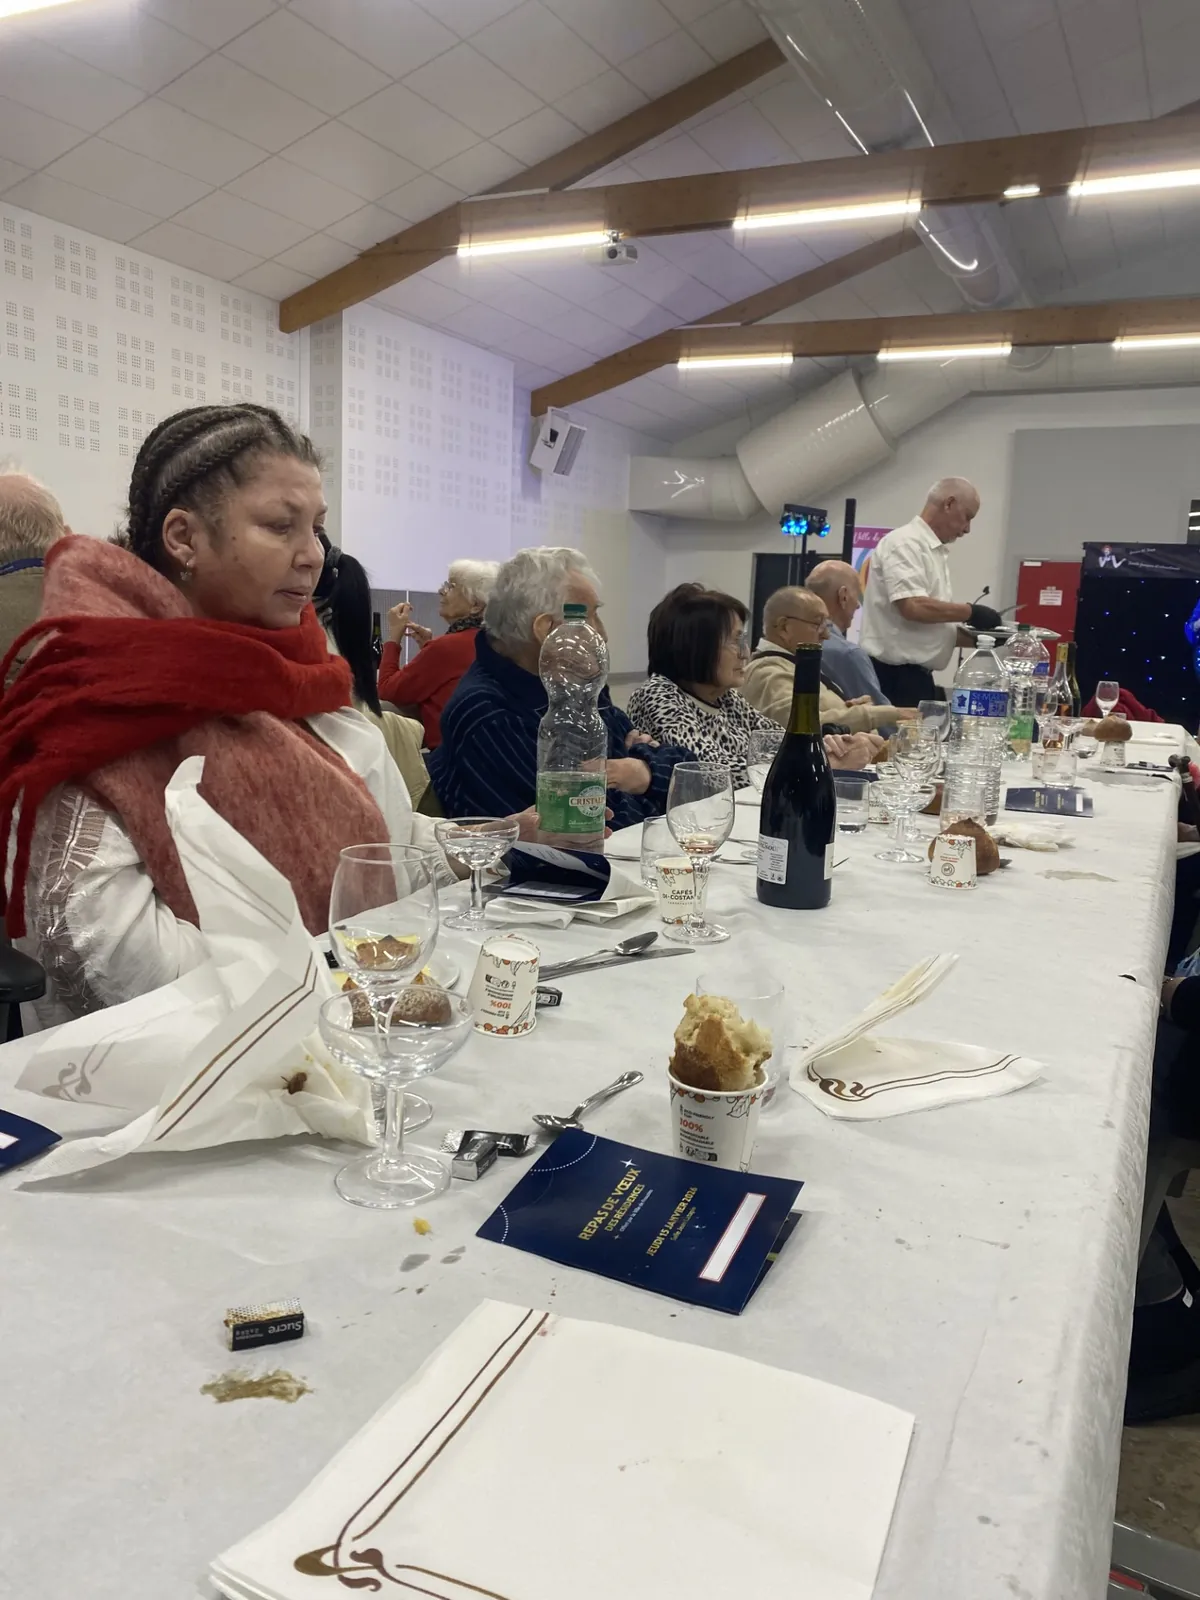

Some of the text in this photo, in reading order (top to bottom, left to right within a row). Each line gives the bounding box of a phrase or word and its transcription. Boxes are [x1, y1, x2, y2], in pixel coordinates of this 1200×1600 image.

[680, 1117, 704, 1133] 100%
[577, 1168, 642, 1241] REPAS DE VŒUX
[604, 1183, 645, 1232] DES RÉSIDENCES
[664, 1201, 689, 1230] JANVIER
[659, 1228, 670, 1237] 15
[646, 1235, 665, 1257] JEUDI
[268, 1321, 302, 1334] Sucre
